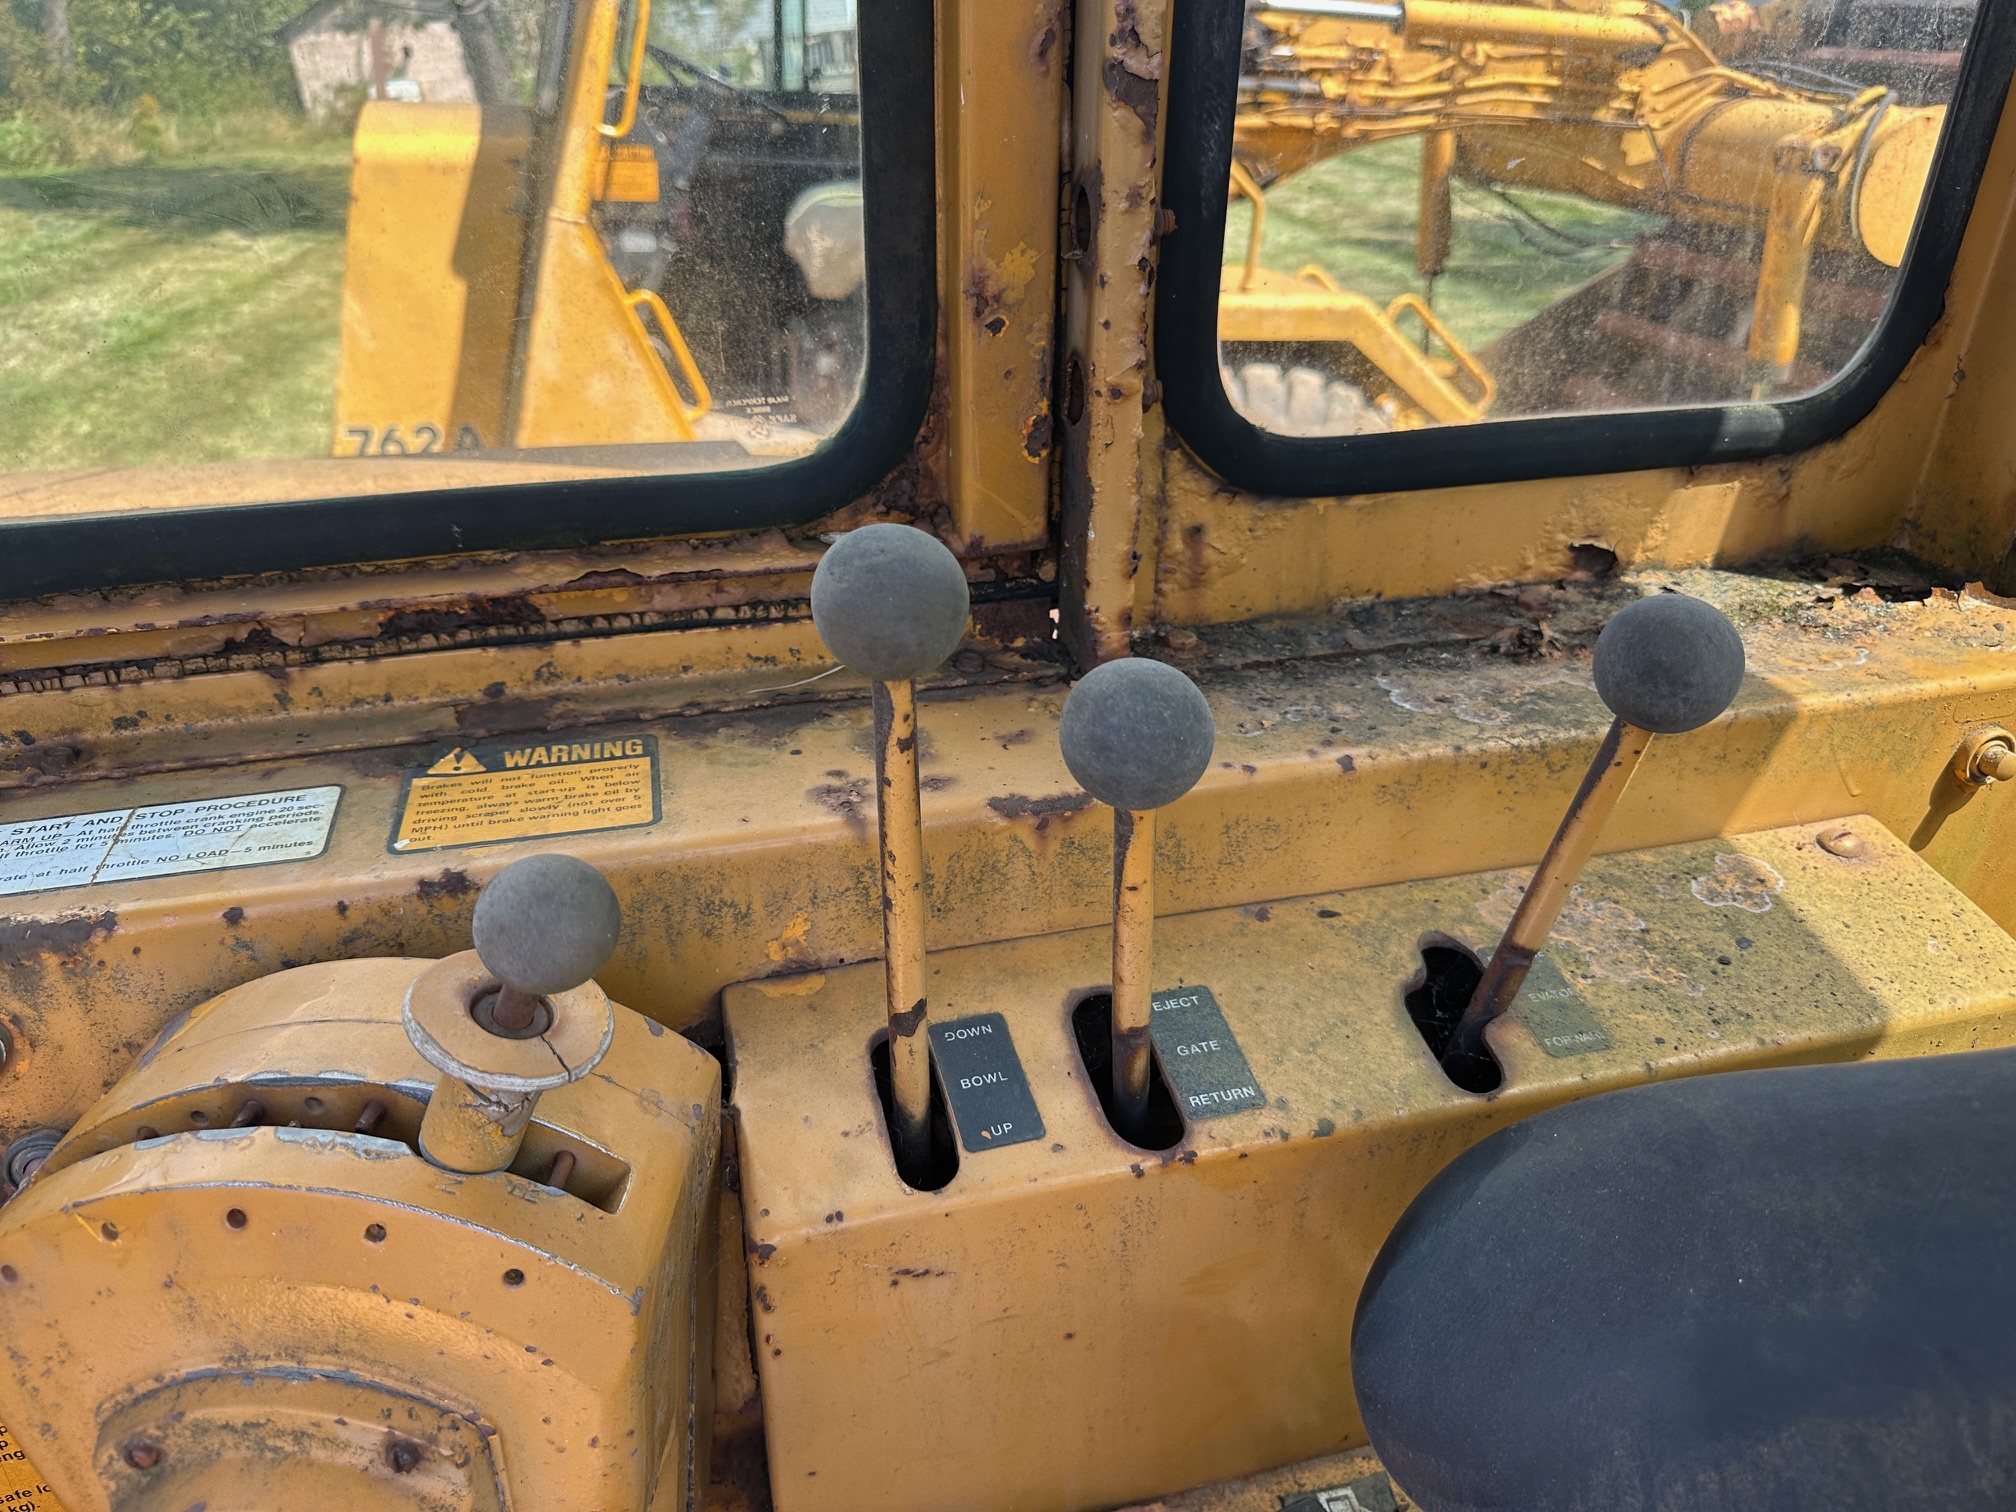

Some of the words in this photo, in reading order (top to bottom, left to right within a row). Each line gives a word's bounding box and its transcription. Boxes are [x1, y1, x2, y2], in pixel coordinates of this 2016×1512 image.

[504, 739, 643, 768] WARNING
[420, 791, 447, 799] with
[501, 782, 536, 790] brake
[580, 774, 614, 782] When
[421, 781, 462, 791] Brakes
[530, 769, 582, 779] function
[589, 763, 640, 774] properly
[415, 806, 470, 816] freezing,
[476, 800, 520, 810] always
[524, 796, 559, 804] warm
[564, 791, 599, 800] brake
[417, 795, 494, 807] temperature
[527, 786, 576, 796] start-up
[604, 779, 641, 787] below
[11, 821, 76, 836] START
[82, 816, 124, 828] AND
[135, 808, 185, 820] STOP
[194, 794, 308, 814] PROCEDURE
[131, 819, 182, 830] throttle
[185, 814, 226, 823] crank
[229, 808, 276, 818] engine
[279, 805, 294, 813] 20
[411, 824, 448, 834] MPH)
[453, 820, 484, 829] until
[488, 816, 524, 825] brake
[528, 811, 579, 821] warning
[583, 806, 612, 815] light
[615, 803, 642, 812] goes
[412, 815, 458, 825] driving
[465, 809, 511, 819] scraper
[519, 802, 560, 813] slowly
[568, 800, 594, 808] (not
[14, 841, 56, 851] Allow
[138, 824, 199, 835] between
[203, 816, 264, 828] cranking
[268, 810, 322, 821] periods.
[15, 846, 69, 857] throttle
[117, 834, 175, 844] minutes.
[183, 829, 205, 837] DO
[212, 824, 243, 833] NOT
[249, 816, 321, 828] accelerate
[35, 870, 51, 878] at
[59, 865, 89, 875] half
[156, 854, 180, 863] NO
[258, 840, 314, 851] minutes
[1152, 995, 1200, 1012] EJECT
[944, 1024, 993, 1042] DOWN
[1176, 1038, 1222, 1057] GATE
[960, 1070, 1008, 1090] BOWL
[1189, 1086, 1256, 1108] RETURN
[990, 1122, 1014, 1137] UP
